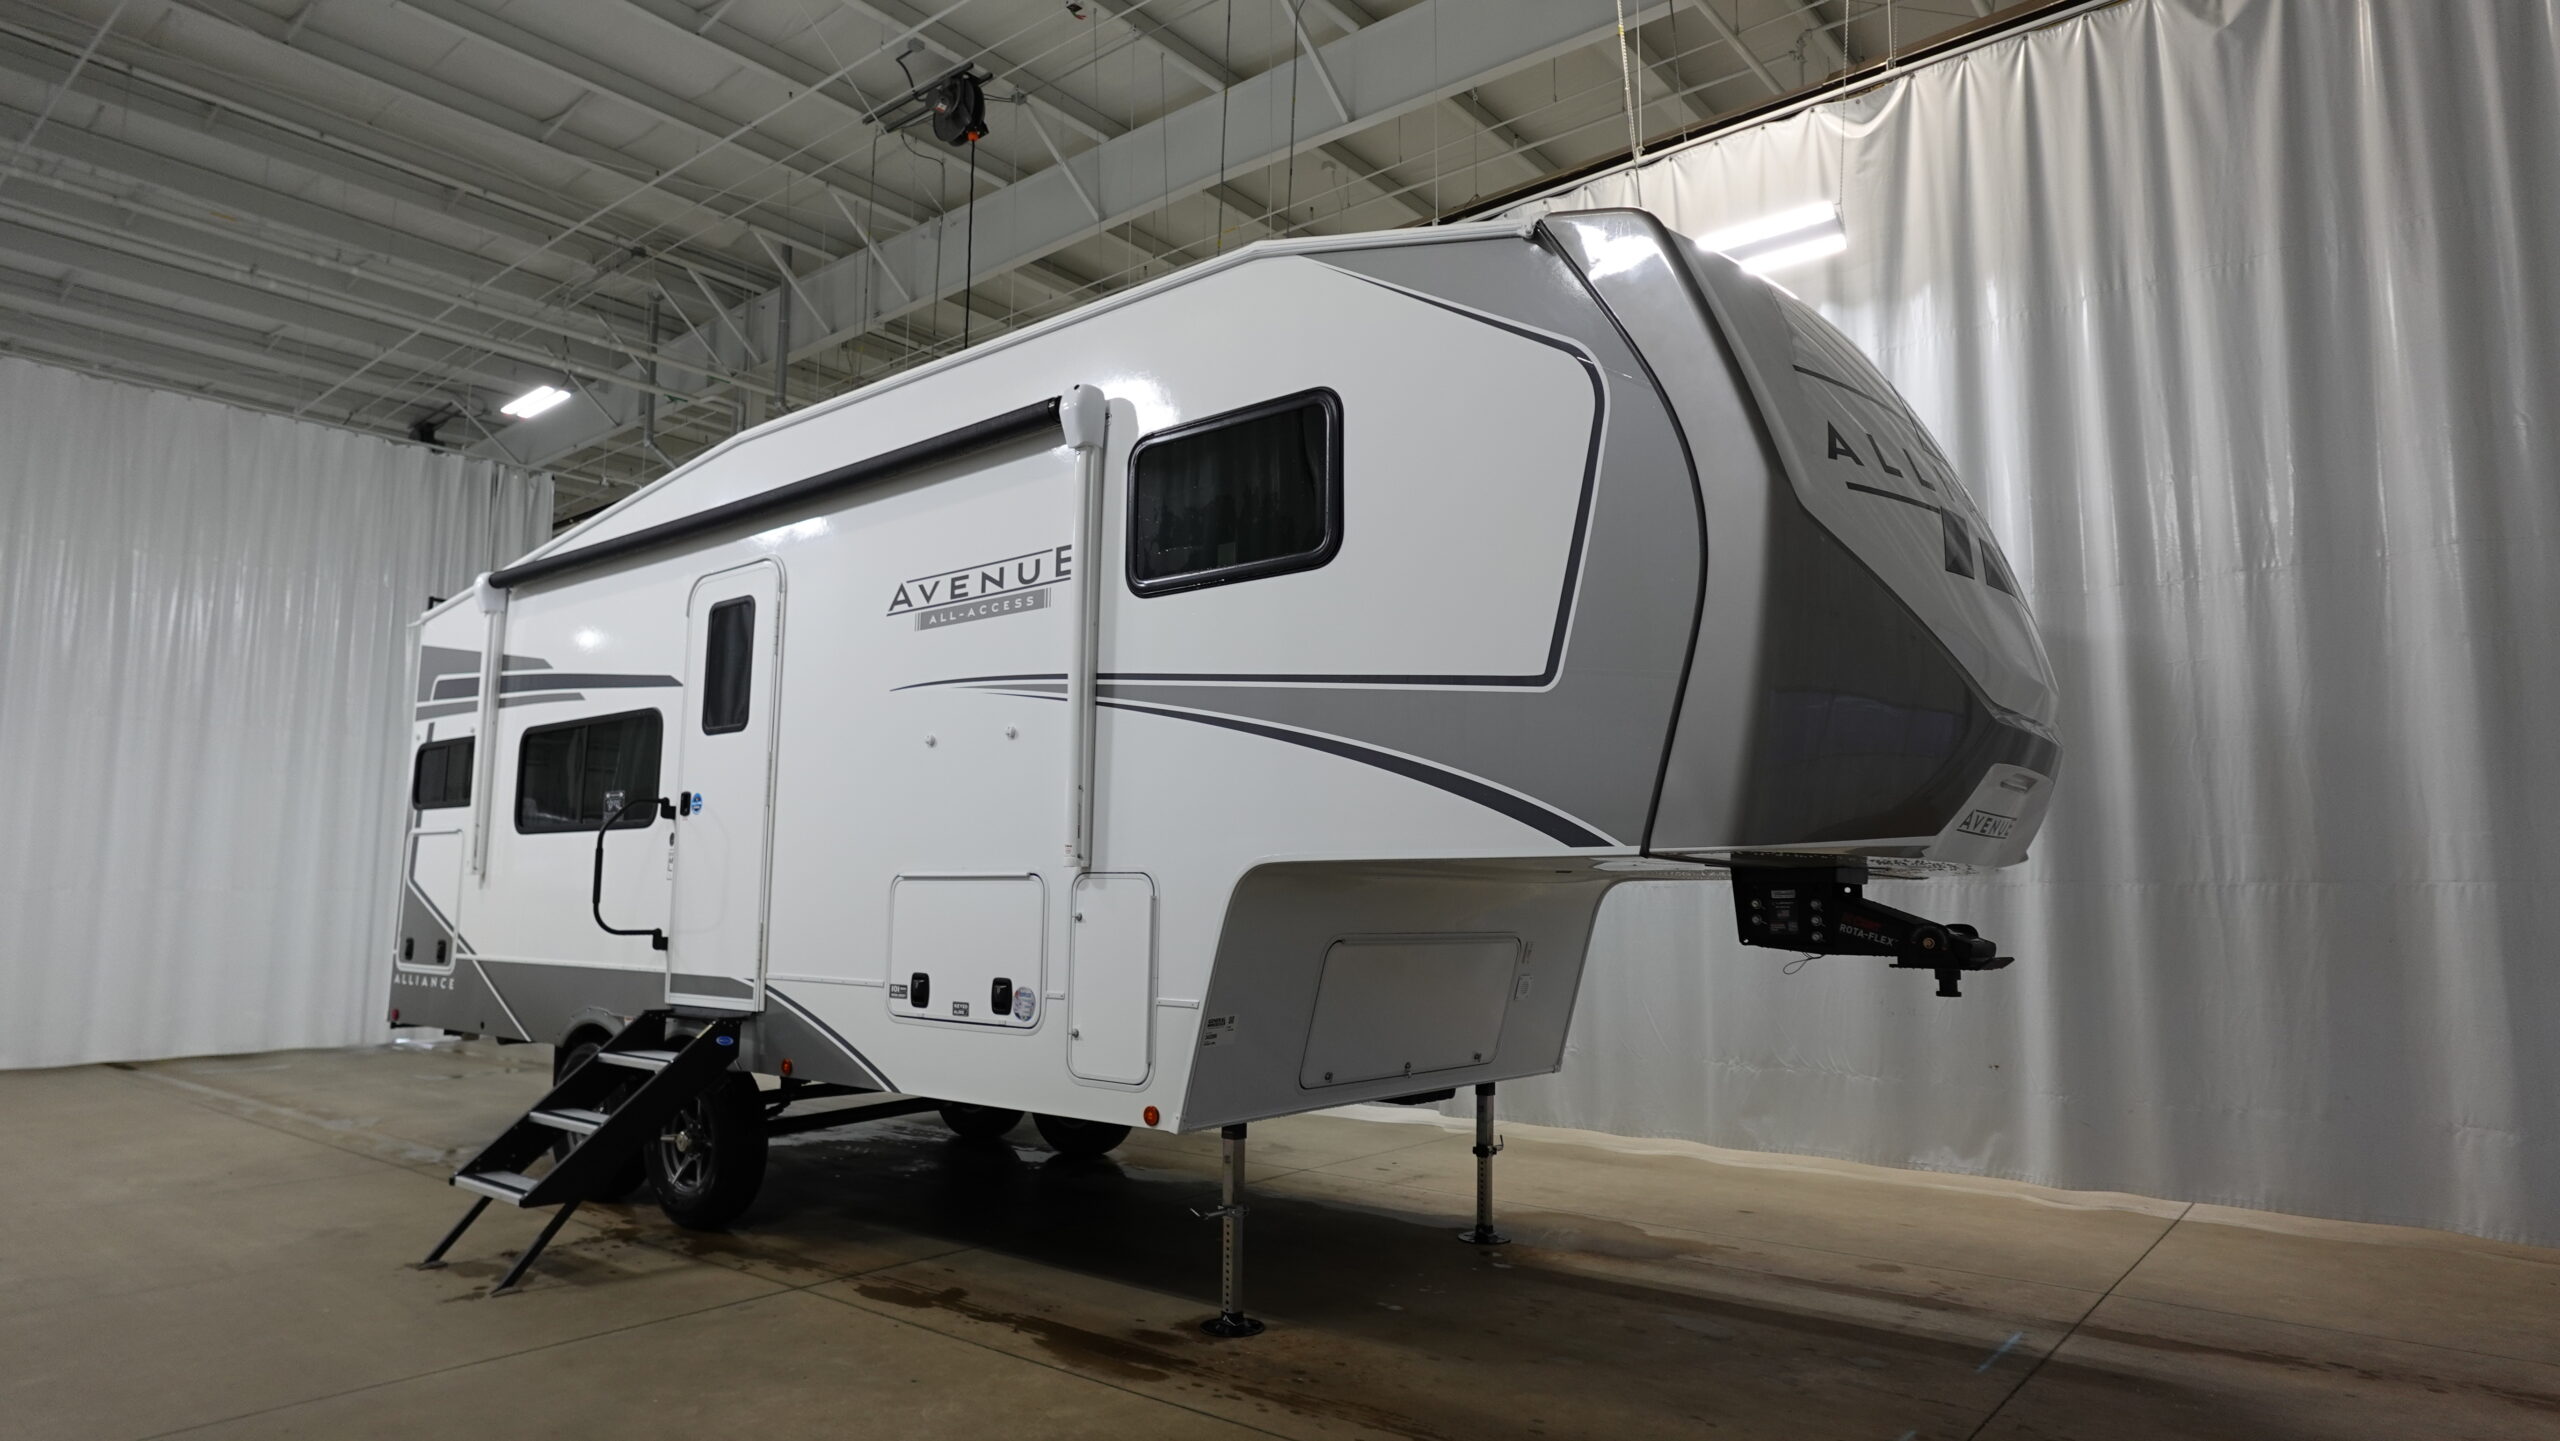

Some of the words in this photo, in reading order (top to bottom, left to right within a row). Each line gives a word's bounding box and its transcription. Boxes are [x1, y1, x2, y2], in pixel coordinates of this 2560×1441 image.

[1828, 420, 1955, 502] ALLI
[888, 544, 1072, 611] AVENUE
[929, 595, 1035, 625] ALL-ACCESS
[1959, 809, 2013, 837] AVENUE
[1839, 923, 1895, 947] ROTA-FLEX
[394, 974, 455, 990] ALLIANCE
